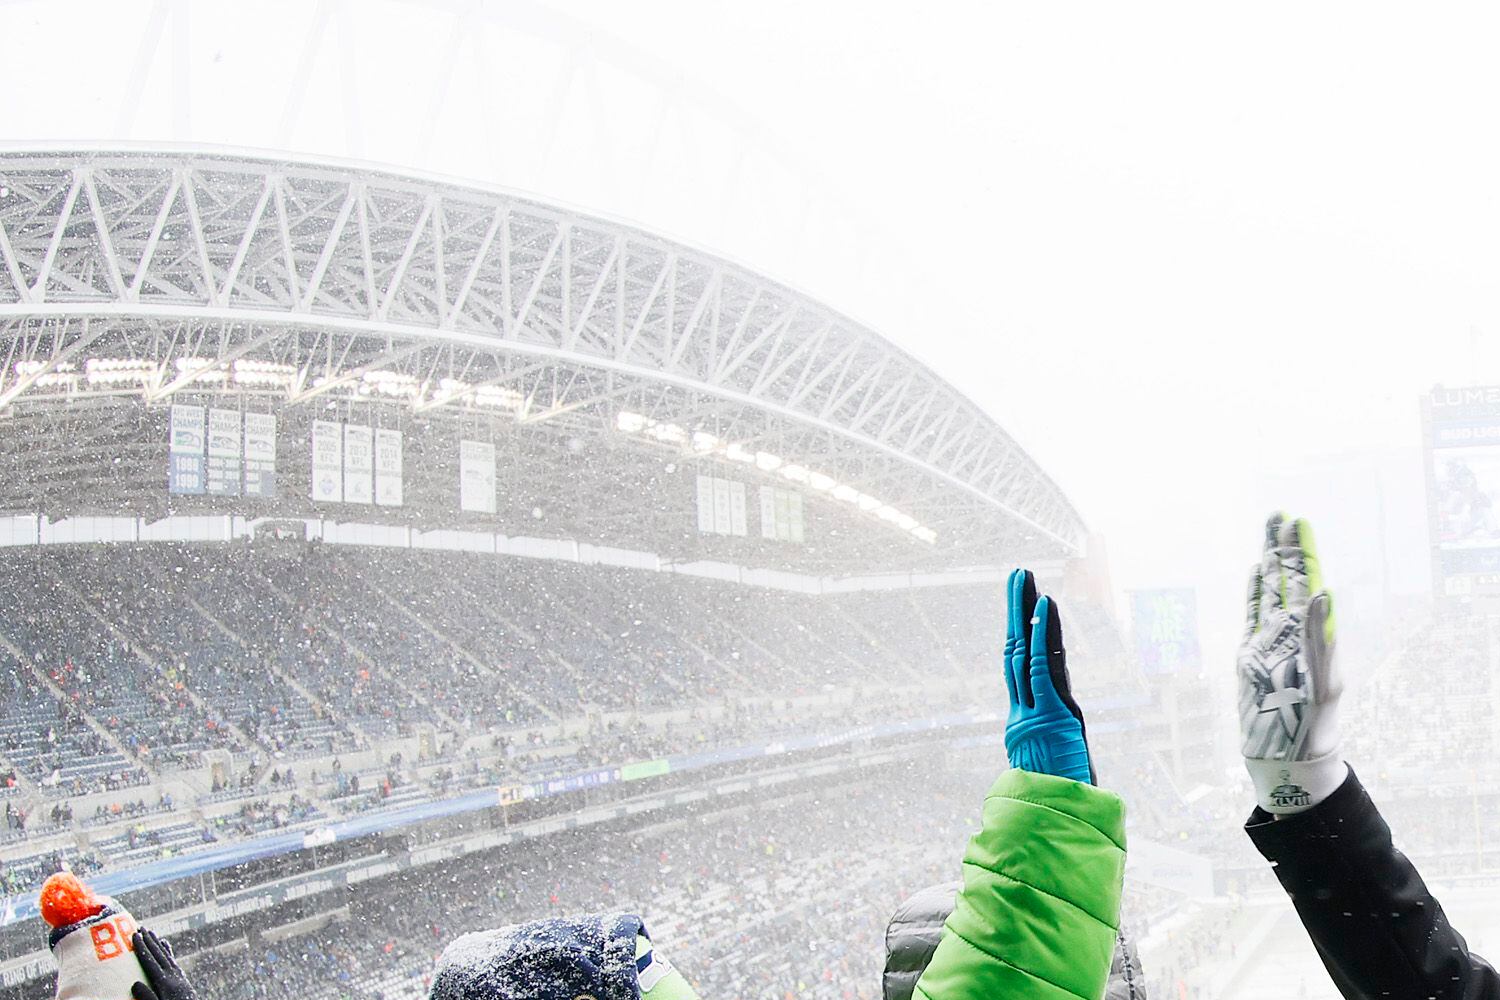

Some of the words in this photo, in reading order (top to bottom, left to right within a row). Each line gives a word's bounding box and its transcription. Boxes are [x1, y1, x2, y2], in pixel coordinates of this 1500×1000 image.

[1150, 618, 1183, 643] ARE
[2, 968, 26, 987] RING
[26, 960, 37, 979] OF
